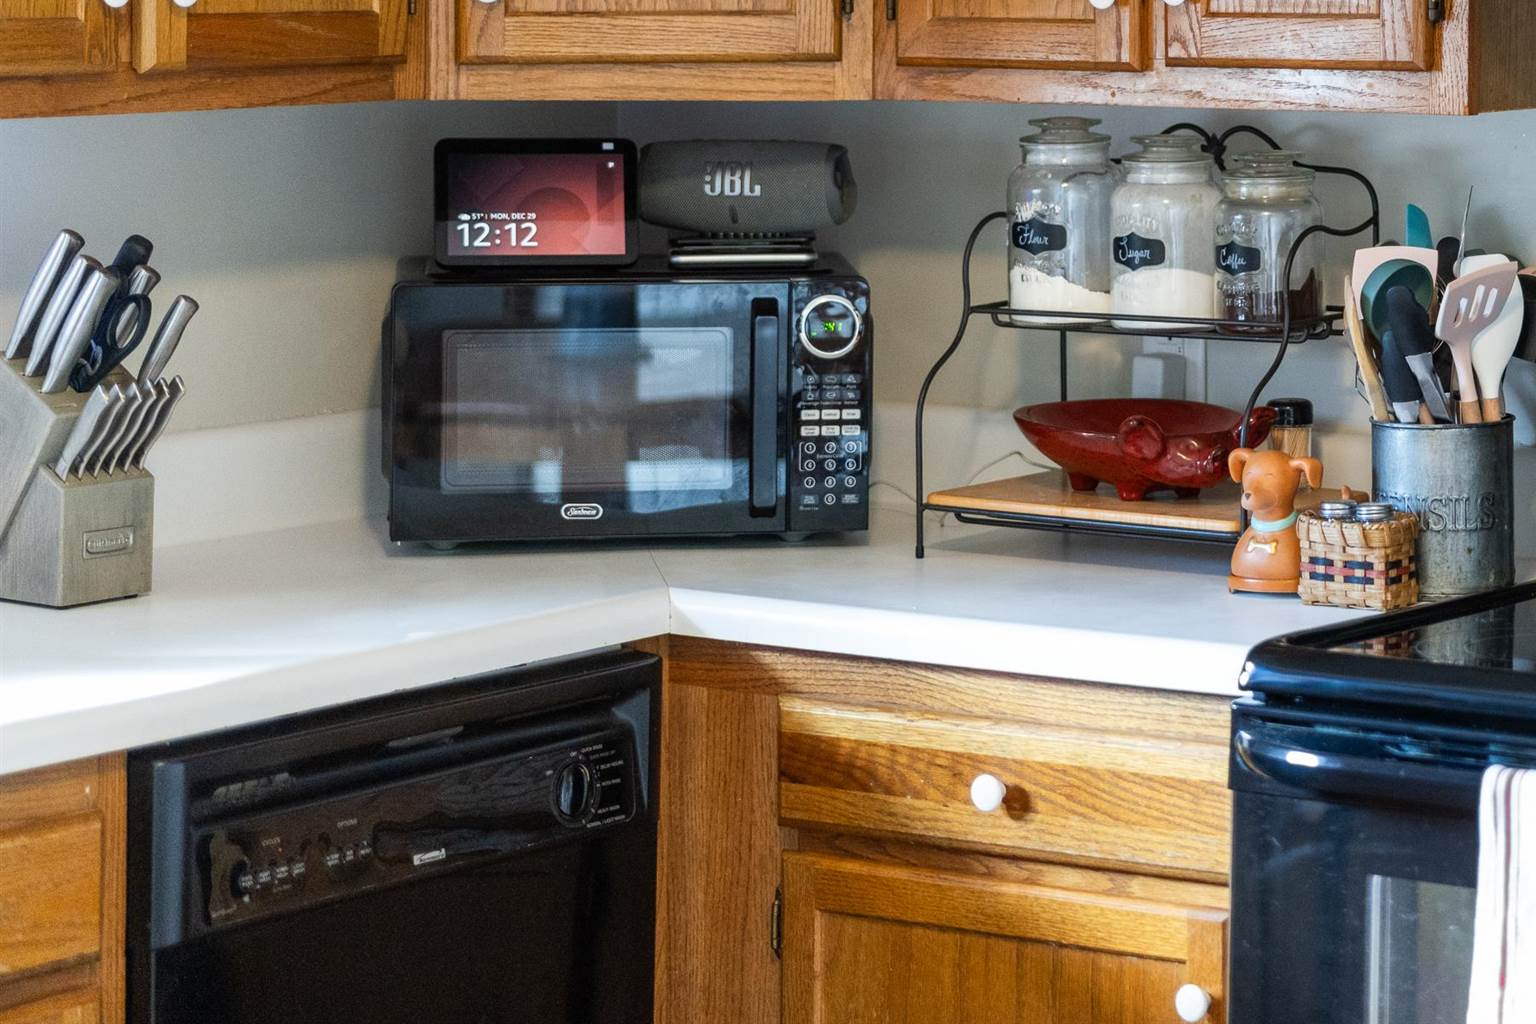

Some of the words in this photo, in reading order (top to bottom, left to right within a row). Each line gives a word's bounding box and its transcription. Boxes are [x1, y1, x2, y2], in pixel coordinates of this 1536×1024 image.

[704, 162, 761, 197] JBL
[456, 222, 539, 247] 12:12
[1017, 223, 1049, 245] Flour
[1119, 236, 1151, 264] Sugar
[1220, 247, 1247, 269] Coffee
[1378, 492, 1497, 531] NSILS
